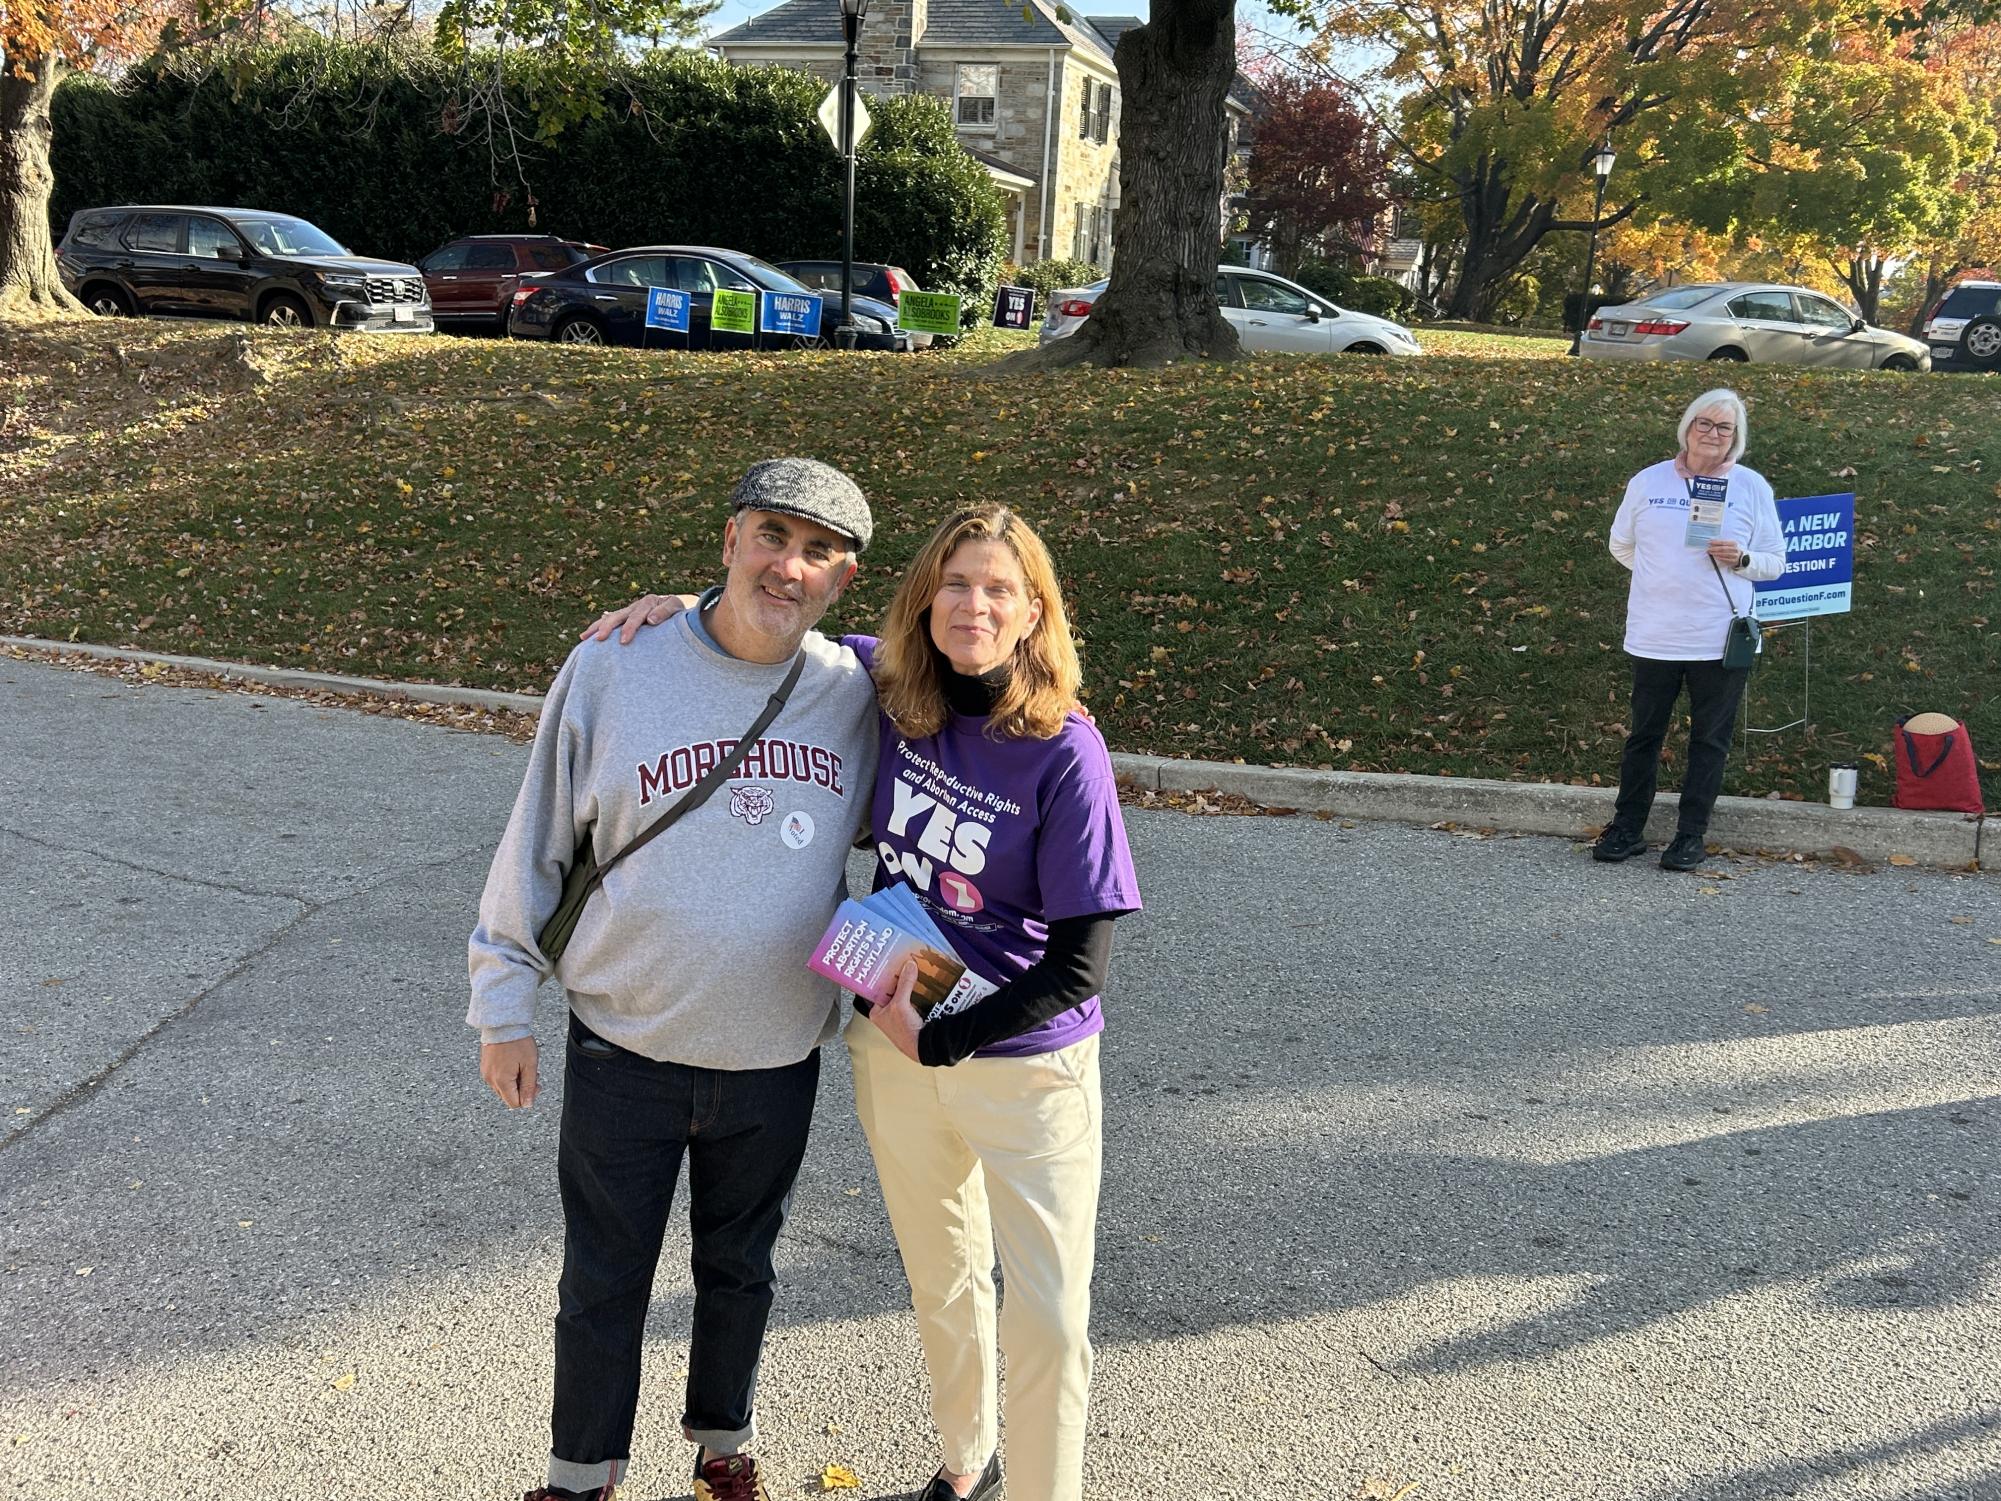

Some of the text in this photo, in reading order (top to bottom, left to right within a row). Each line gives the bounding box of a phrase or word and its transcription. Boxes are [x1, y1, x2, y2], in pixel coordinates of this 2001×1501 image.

[656, 292, 682, 310] HARRIS
[774, 296, 810, 314] HARRIS
[905, 296, 934, 308] ANGELA
[1008, 296, 1025, 310] YES
[658, 308, 678, 318] WALZ
[780, 312, 804, 322] WALZ
[903, 306, 951, 320] ALSOBROOKS
[1006, 312, 1015, 320] ON
[1784, 512, 1841, 533] A NEW
[1782, 558, 1836, 574] ESTION F
[637, 738, 844, 806] MOREHOUSE
[897, 740, 932, 771] Protect
[984, 792, 1021, 816] Rights
[902, 768, 926, 784] and
[957, 800, 997, 824] Access
[887, 777, 992, 876] YES
[878, 841, 932, 892] ON
[822, 920, 853, 966] PROTECT
[835, 920, 869, 972] ABORTION
[844, 930, 877, 978] RIGHTS IN
[854, 927, 893, 984] MARYLAND
[952, 990, 963, 1004] ON
[924, 1002, 943, 1022] VOTE
